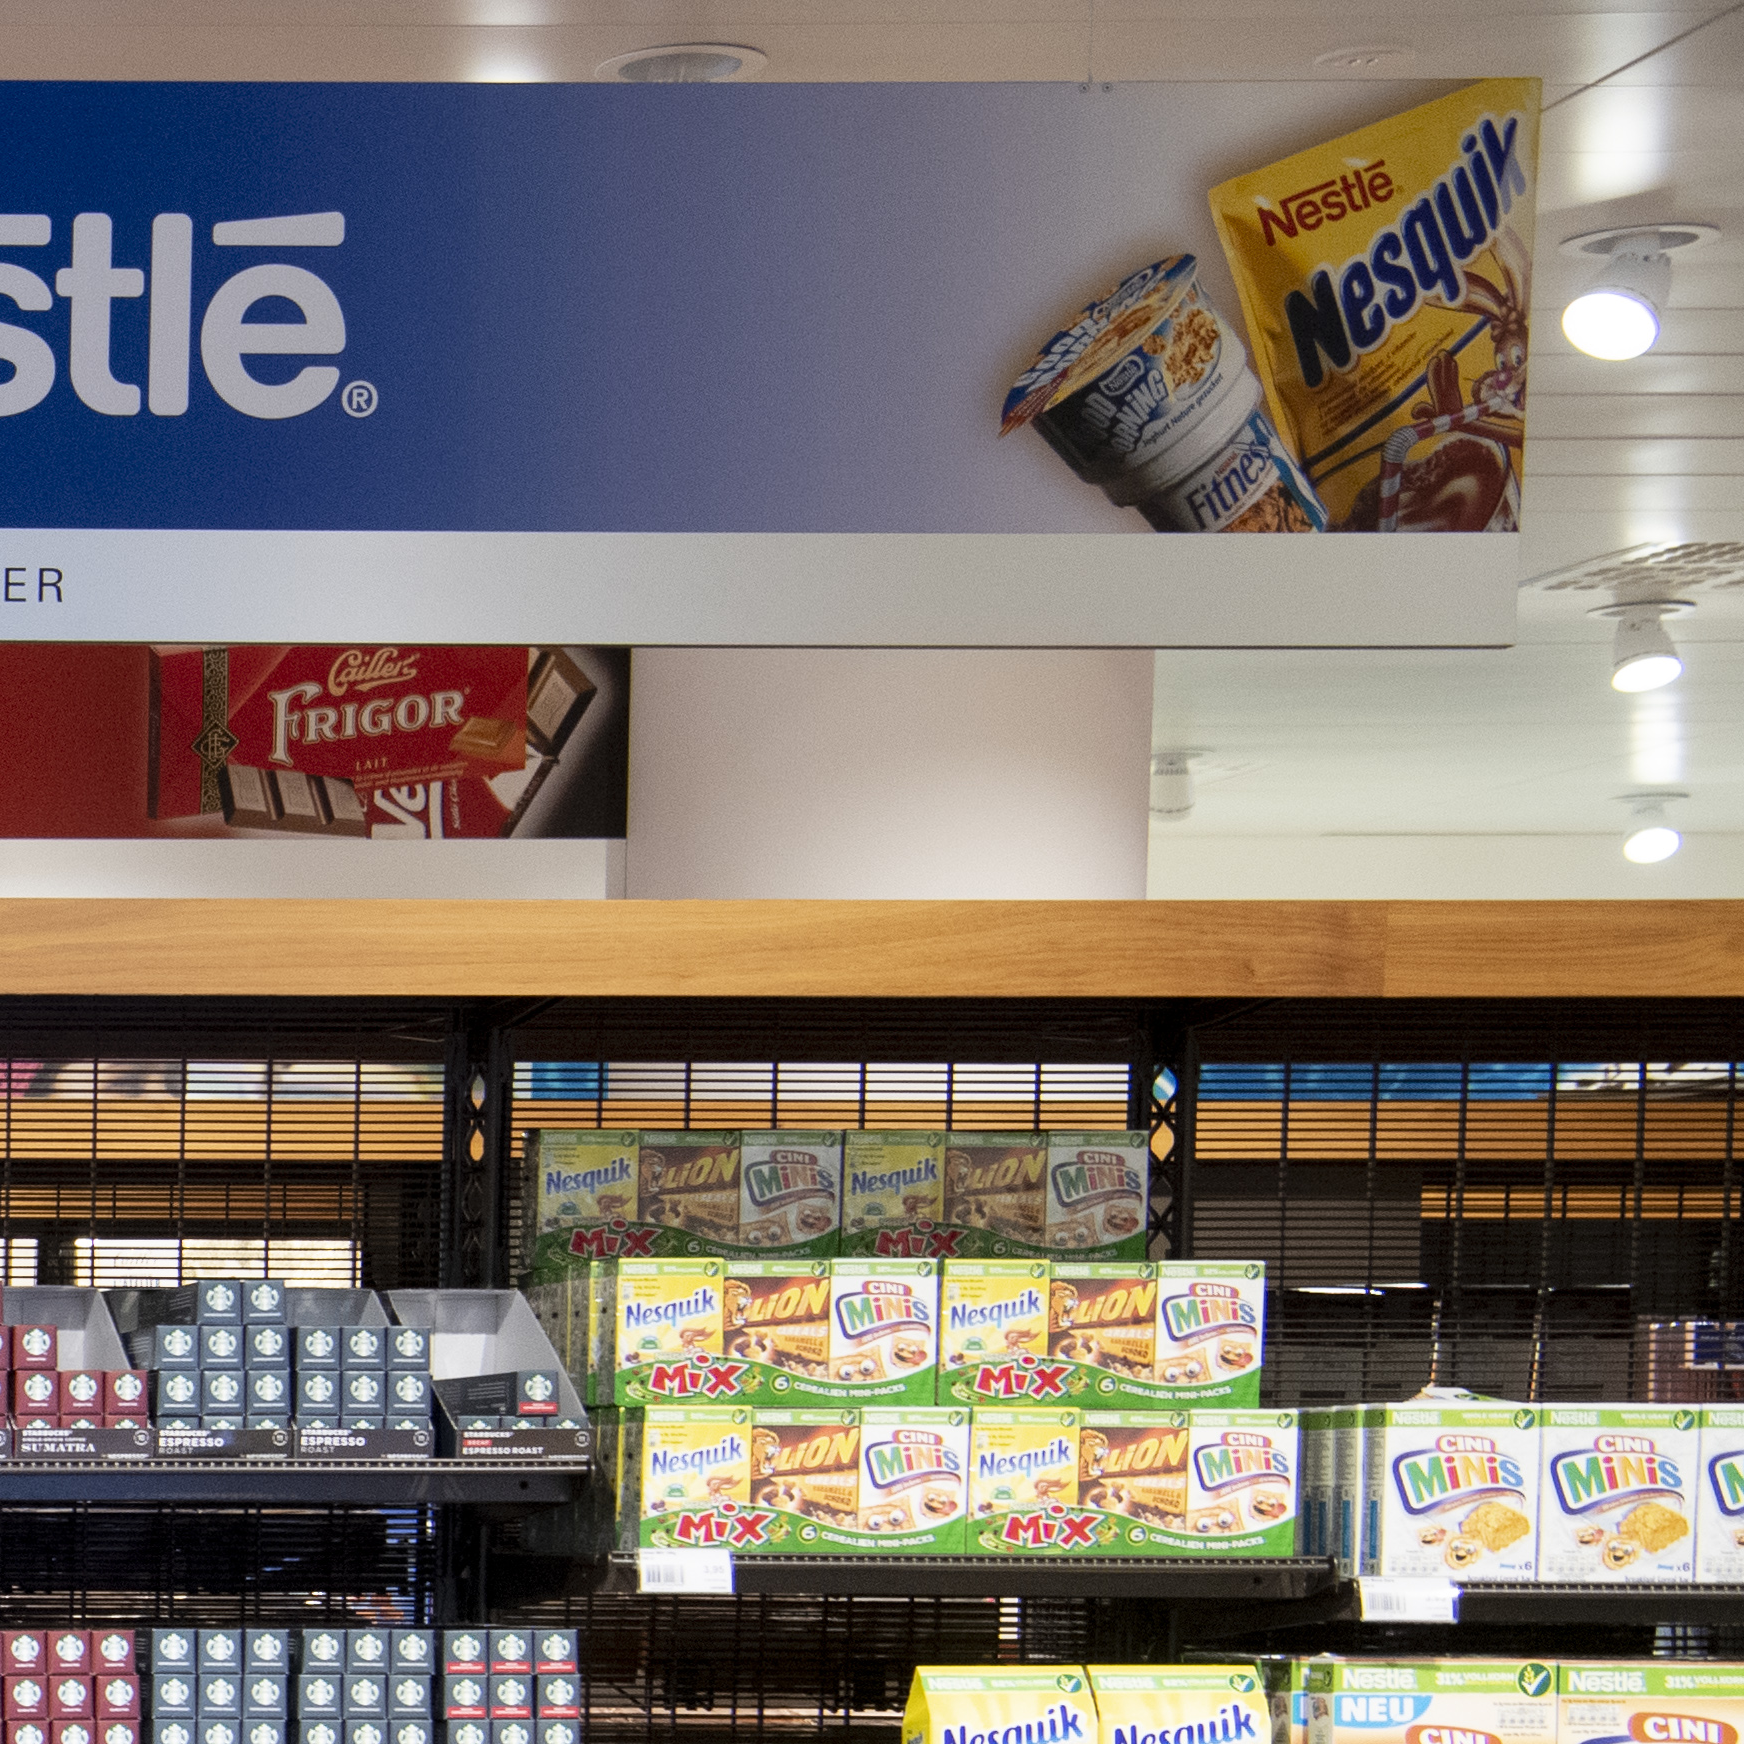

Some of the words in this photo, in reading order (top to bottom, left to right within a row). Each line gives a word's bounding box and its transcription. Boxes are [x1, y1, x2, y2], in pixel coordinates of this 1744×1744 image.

[1257, 160, 1396, 247] Nestlé
[1285, 116, 1527, 388] Nesquik
[268, 681, 464, 767] FRIGOR
[545, 1157, 631, 1195] Nesquik
[870, 1282, 904, 1295] CINI
[1196, 1284, 1231, 1297] CINI
[626, 1288, 714, 1328] Nesquik
[951, 1290, 1040, 1329] Nesquik
[21, 1443, 95, 1453] SUMATRA
[159, 1437, 224, 1447] ESPRESSO
[301, 1436, 366, 1446] ESPRESSO
[462, 1447, 510, 1455] ESPRESSO
[513, 1447, 543, 1455] ROAST
[1439, 1436, 1492, 1452] CINI
[1598, 1436, 1652, 1453] CINI
[652, 1437, 742, 1476] Nesquik
[1342, 1669, 1413, 1689] Nestlé
[1435, 1672, 1464, 1685] 31%
[1568, 1670, 1644, 1692] Nestlé
[1665, 1675, 1695, 1689] 31%
[1340, 1697, 1414, 1722] NEU
[1643, 1716, 1721, 1744] CINI
